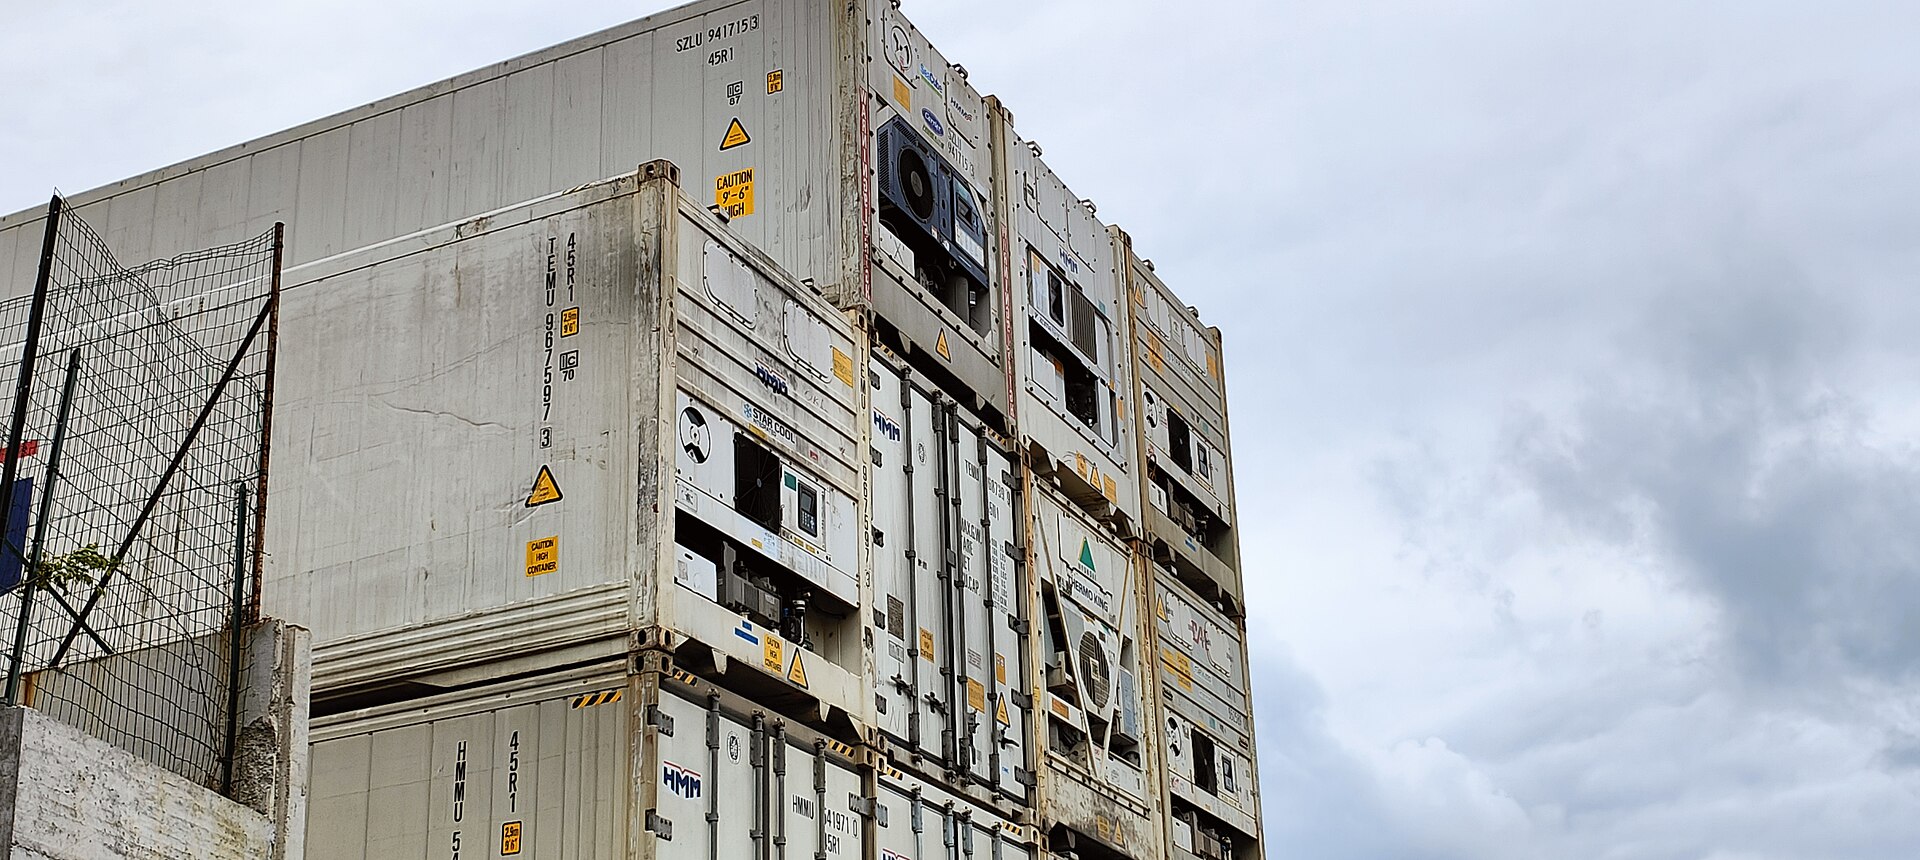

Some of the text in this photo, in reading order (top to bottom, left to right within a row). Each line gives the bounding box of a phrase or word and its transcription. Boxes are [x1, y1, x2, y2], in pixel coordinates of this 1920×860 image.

[676, 32, 703, 53] SZLU
[708, 47, 734, 66] 45R1
[729, 95, 741, 106] 87
[717, 169, 752, 191] CAUTION
[567, 232, 575, 302] 45R1
[541, 237, 556, 447] TEMU 967597 3
[562, 369, 575, 382] 70
[753, 408, 795, 444] STAR COOL
[873, 409, 900, 443] HMM
[531, 539, 554, 551] CAUTION
[535, 552, 549, 562] HIGH
[527, 562, 556, 574] CONTAINER
[1067, 573, 1109, 613] THERMO KING
[453, 741, 467, 822] HMMU
[509, 731, 519, 813] 45R1
[663, 764, 701, 799] HMM
[792, 794, 814, 820] HMMU
